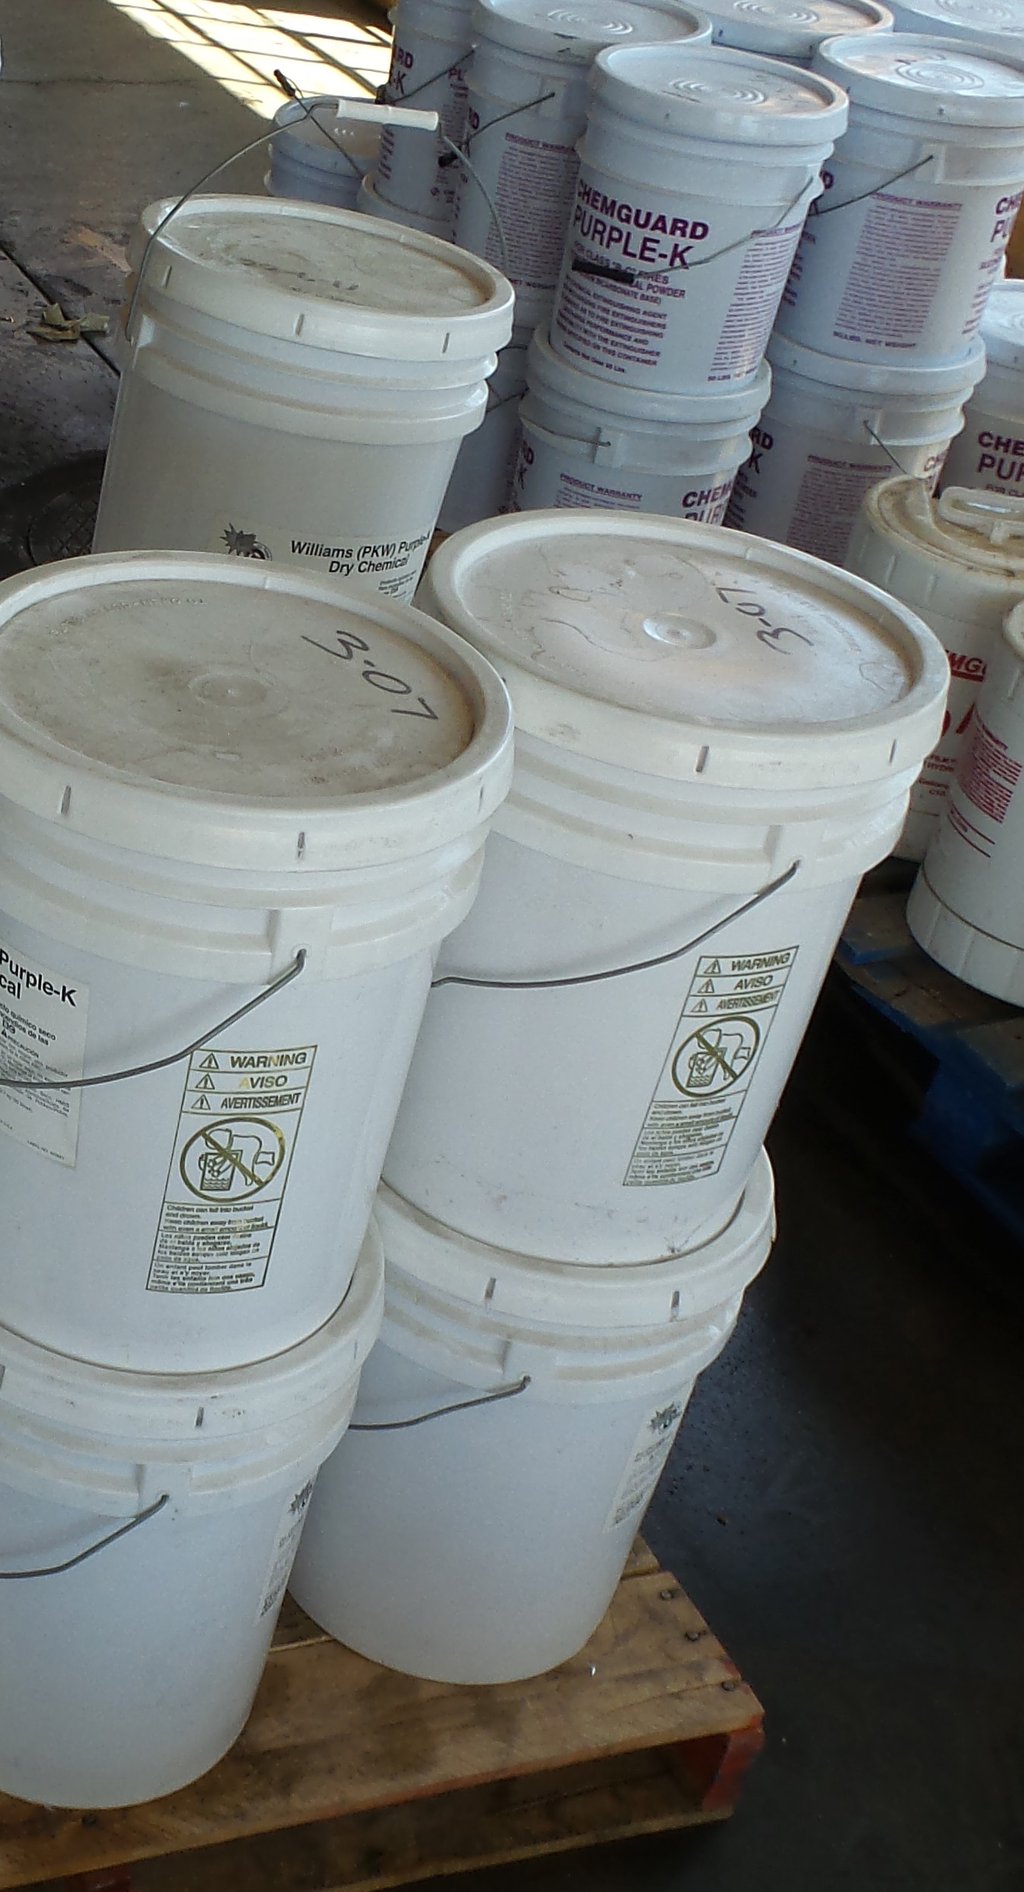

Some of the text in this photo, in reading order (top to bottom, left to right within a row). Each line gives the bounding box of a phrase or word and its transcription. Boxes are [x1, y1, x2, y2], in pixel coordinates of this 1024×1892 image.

[573, 204, 694, 269] PURPLE-K
[647, 283, 686, 298] POWDER
[291, 540, 353, 559] Williams
[357, 542, 396, 561] (PKW)
[329, 556, 409, 576] Dry Chemical
[730, 953, 791, 972] WARNING
[0, 948, 77, 1008] Purple-K
[734, 975, 773, 990] AVISO
[716, 990, 780, 1011] AVERTISSEMENT
[39, 1028, 55, 1040] seco
[229, 1052, 307, 1069] WARNING
[238, 1075, 288, 1090] AVISO
[221, 1092, 303, 1109] AVERTISSEMENT
